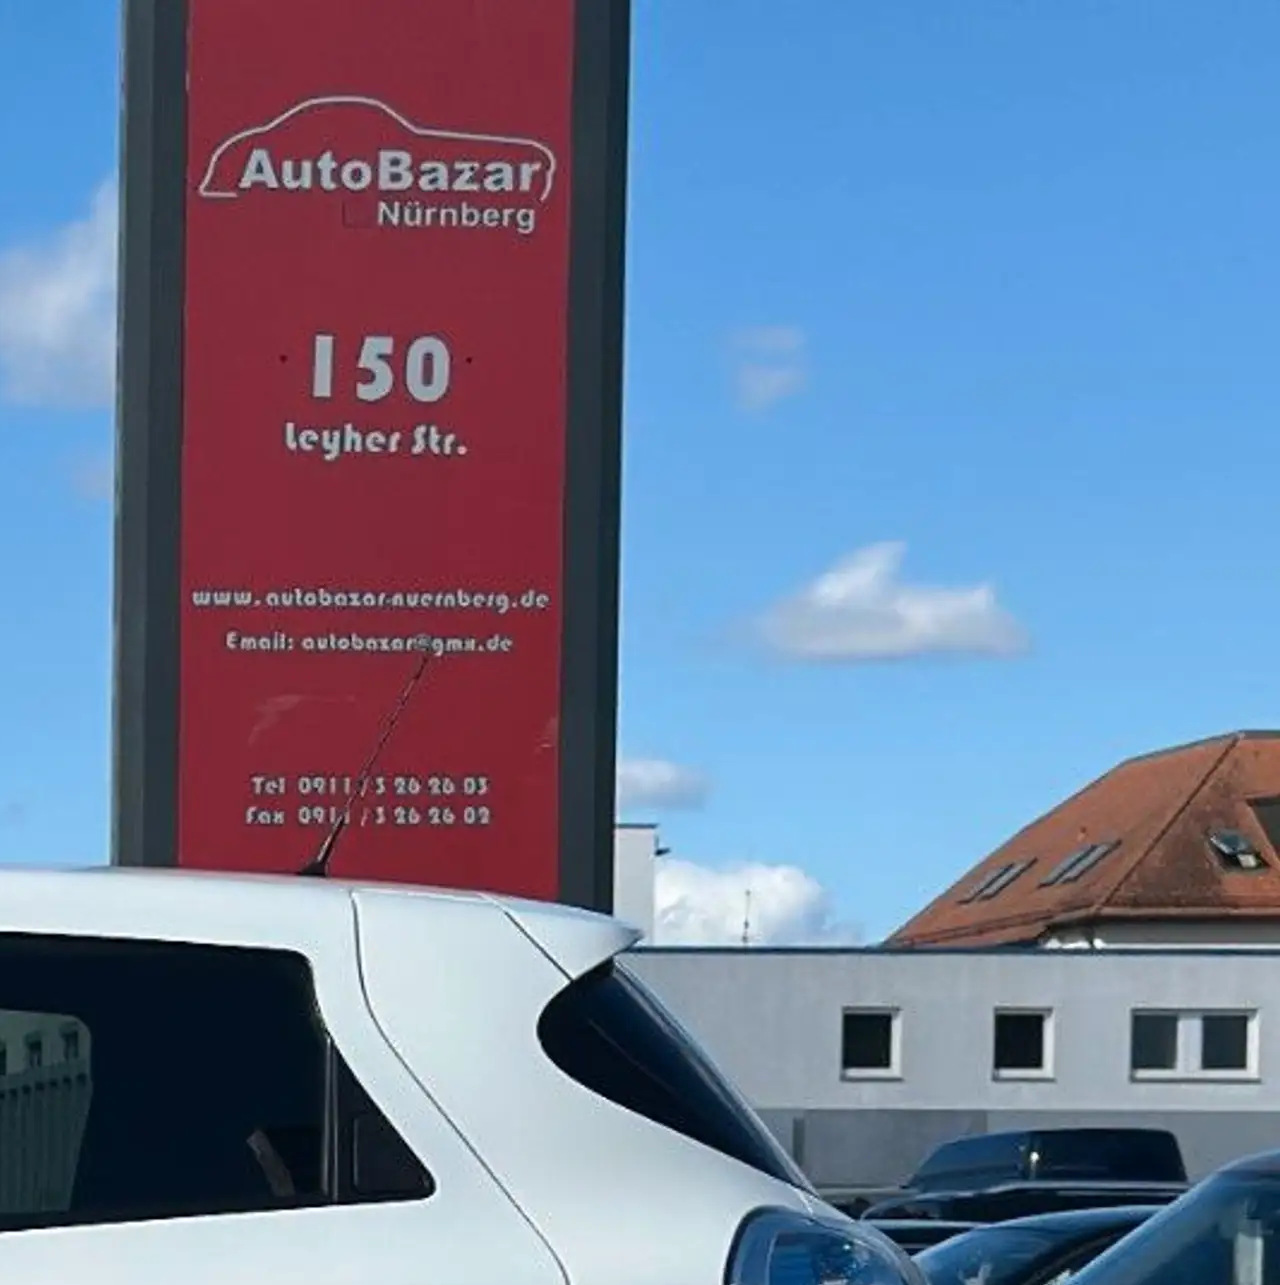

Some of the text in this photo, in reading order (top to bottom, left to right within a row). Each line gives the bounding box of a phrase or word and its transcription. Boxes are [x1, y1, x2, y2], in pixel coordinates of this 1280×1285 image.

[239, 148, 541, 192] AutoBazar
[376, 201, 535, 234] Nürnberg
[411, 424, 468, 456] Str.
[192, 588, 550, 614] www.autobazar-nuernberg.de
[226, 631, 513, 657] Email: autobazar@gmx.de
[250, 776, 286, 795] Tel
[298, 776, 351, 795] 0911
[394, 776, 421, 795] 26
[427, 776, 456, 795] 26
[463, 776, 489, 795] 03
[245, 805, 285, 825] Fax
[394, 805, 421, 825] 26
[427, 805, 456, 825] 26
[463, 805, 490, 825] 02
